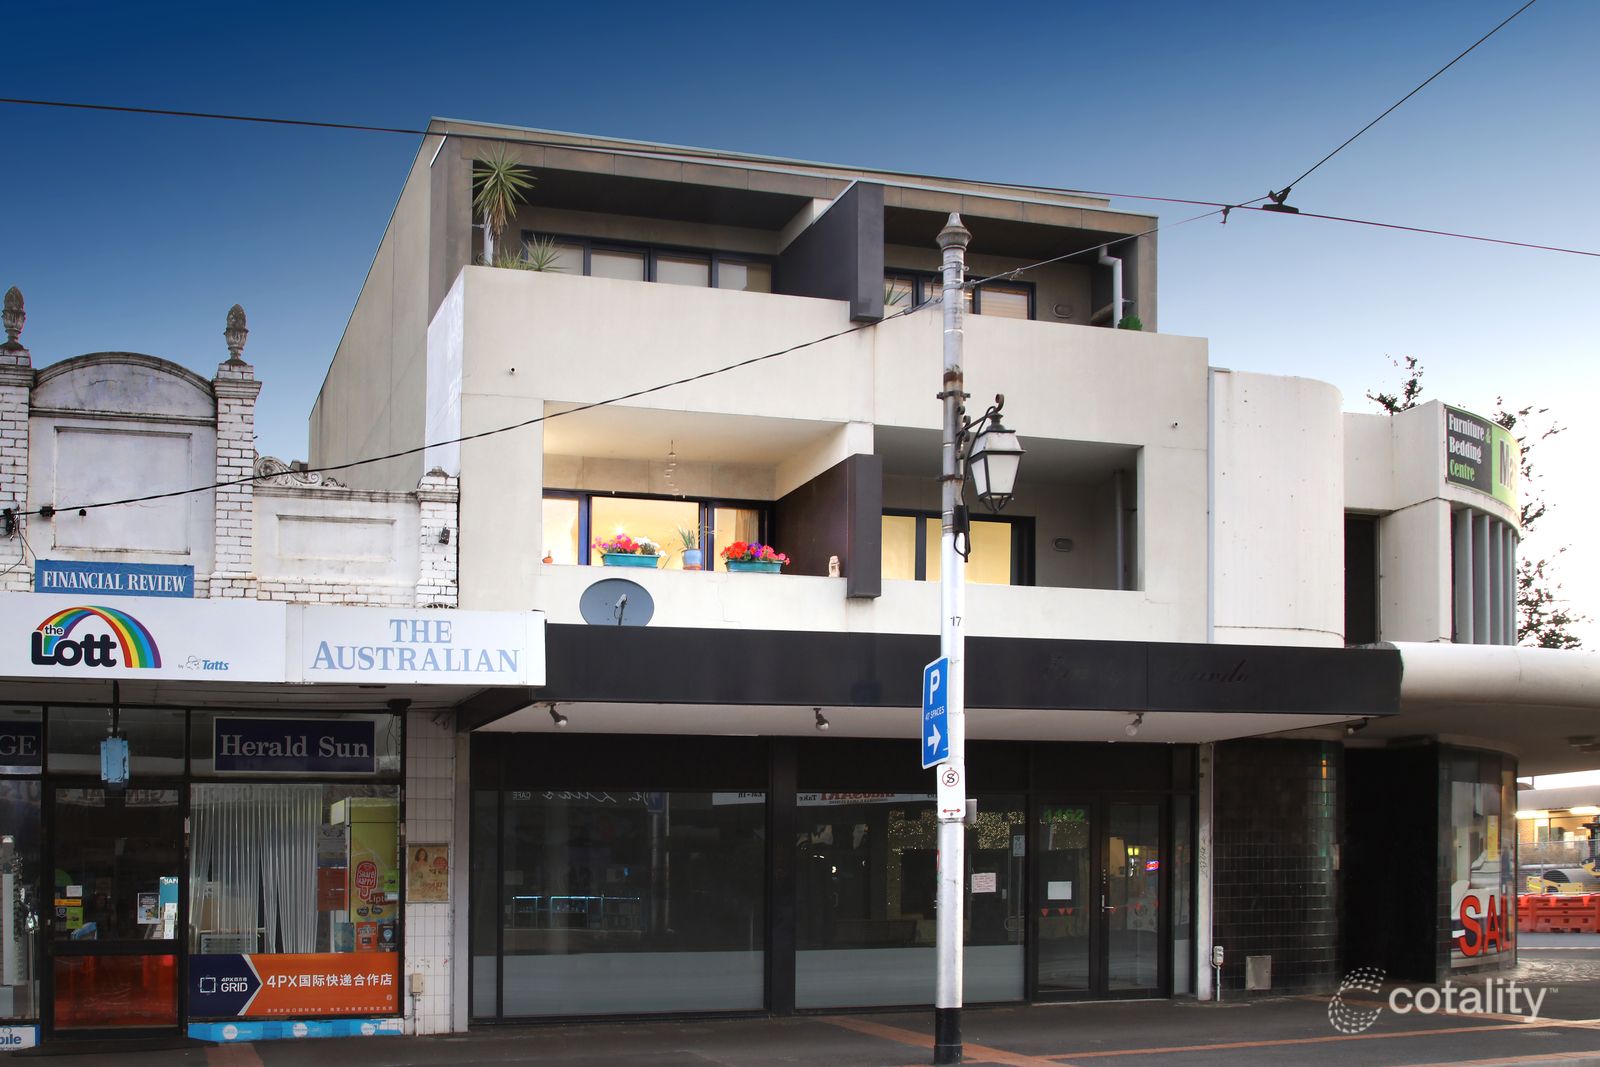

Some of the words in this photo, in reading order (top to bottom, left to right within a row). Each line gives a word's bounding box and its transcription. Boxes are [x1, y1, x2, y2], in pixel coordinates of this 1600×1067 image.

[1448, 413, 1485, 441] Furniture
[1485, 427, 1491, 443] &
[1449, 436, 1482, 464] Bedding
[1449, 459, 1475, 481] Centre
[42, 571, 124, 590] FINANCIAL
[127, 573, 187, 592] REVIEW
[44, 624, 64, 635] the
[389, 618, 452, 644] THE
[950, 616, 962, 627] 17
[31, 631, 117, 667] Lott
[309, 640, 520, 673] AUSTRALIAN
[201, 659, 230, 671] Tatts
[929, 668, 941, 705] P
[930, 705, 945, 720] SPACES
[219, 734, 310, 758] Herald
[318, 735, 370, 758] Sun
[946, 772, 956, 785] S
[220, 982, 248, 993] GRID
